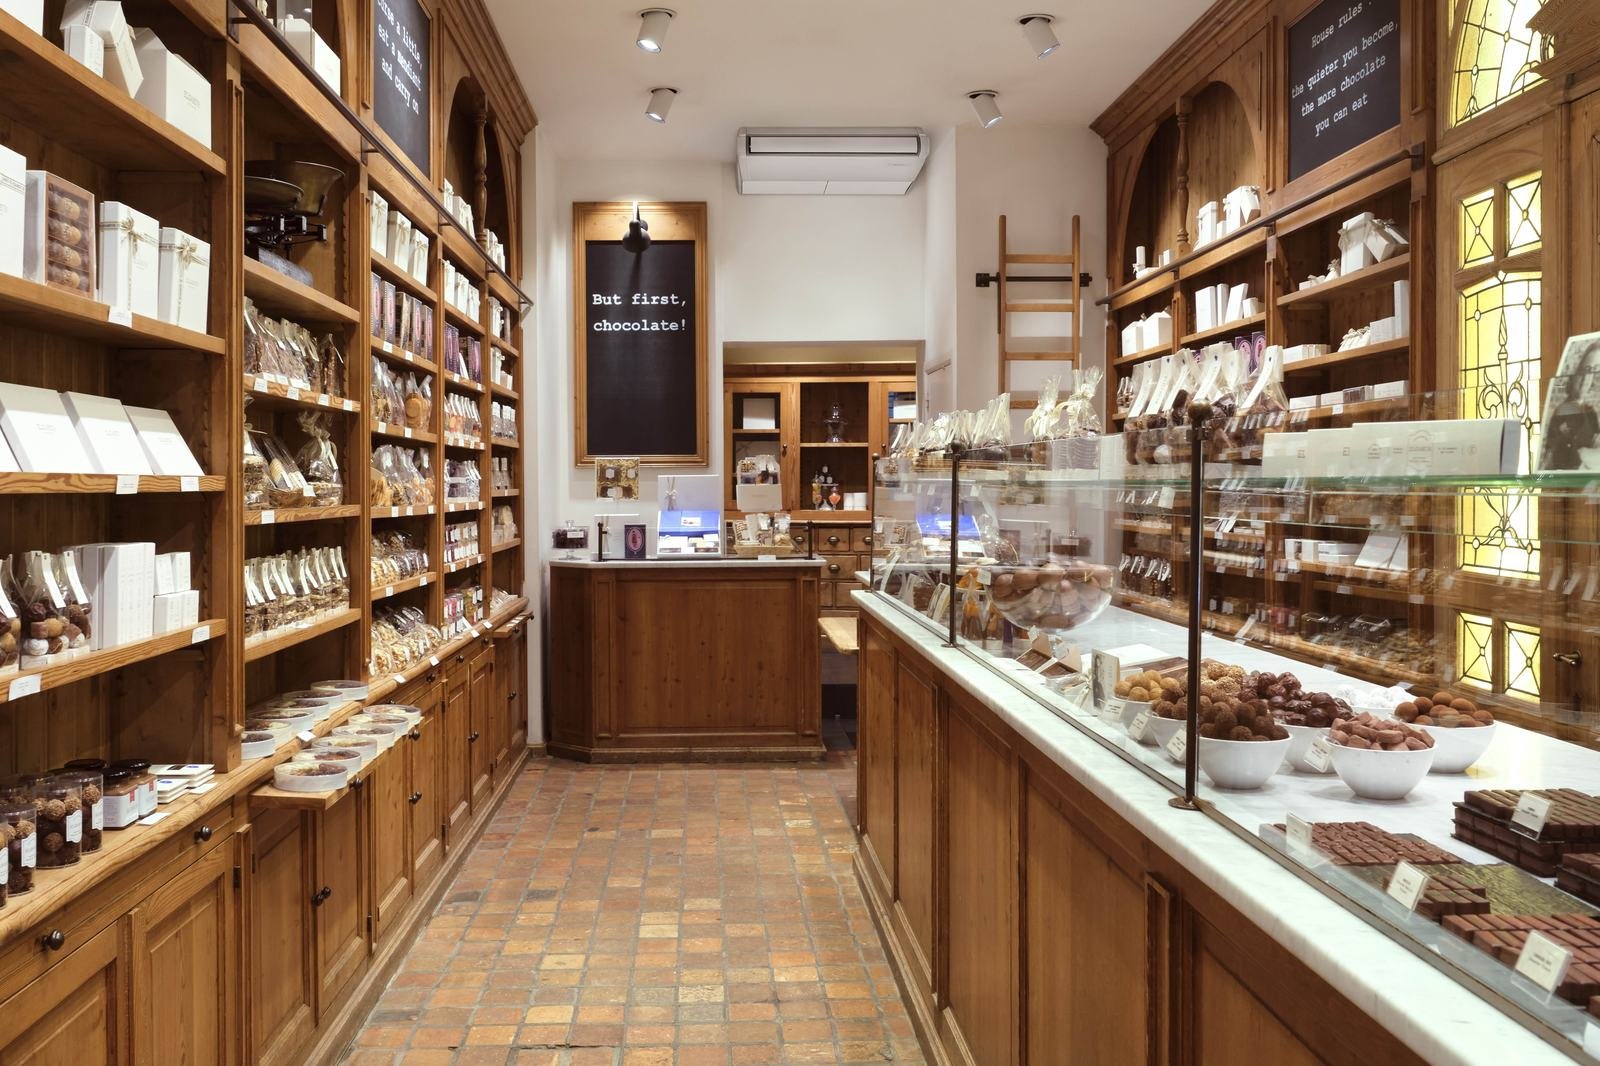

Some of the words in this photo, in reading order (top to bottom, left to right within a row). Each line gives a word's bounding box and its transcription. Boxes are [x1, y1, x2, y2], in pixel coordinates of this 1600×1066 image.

[378, 24, 389, 47] eat
[391, 42, 396, 56] a
[396, 21, 401, 36] a
[1312, 25, 1334, 48] House
[1338, 2, 1363, 28] rules
[1292, 84, 1304, 98] the
[1307, 58, 1339, 90] quieter
[1342, 46, 1358, 67] you
[1362, 20, 1398, 50] become,
[382, 57, 393, 81] and
[394, 75, 411, 108] carry
[412, 98, 419, 115] on
[1301, 101, 1314, 116] the
[1317, 87, 1336, 106] more
[1340, 55, 1386, 91] chocolate
[1314, 117, 1329, 137] you
[1333, 107, 1348, 122] can
[1352, 94, 1368, 111] eat
[592, 293, 622, 305] But
[631, 293, 686, 307] first,
[593, 319, 686, 331] chocolate!
